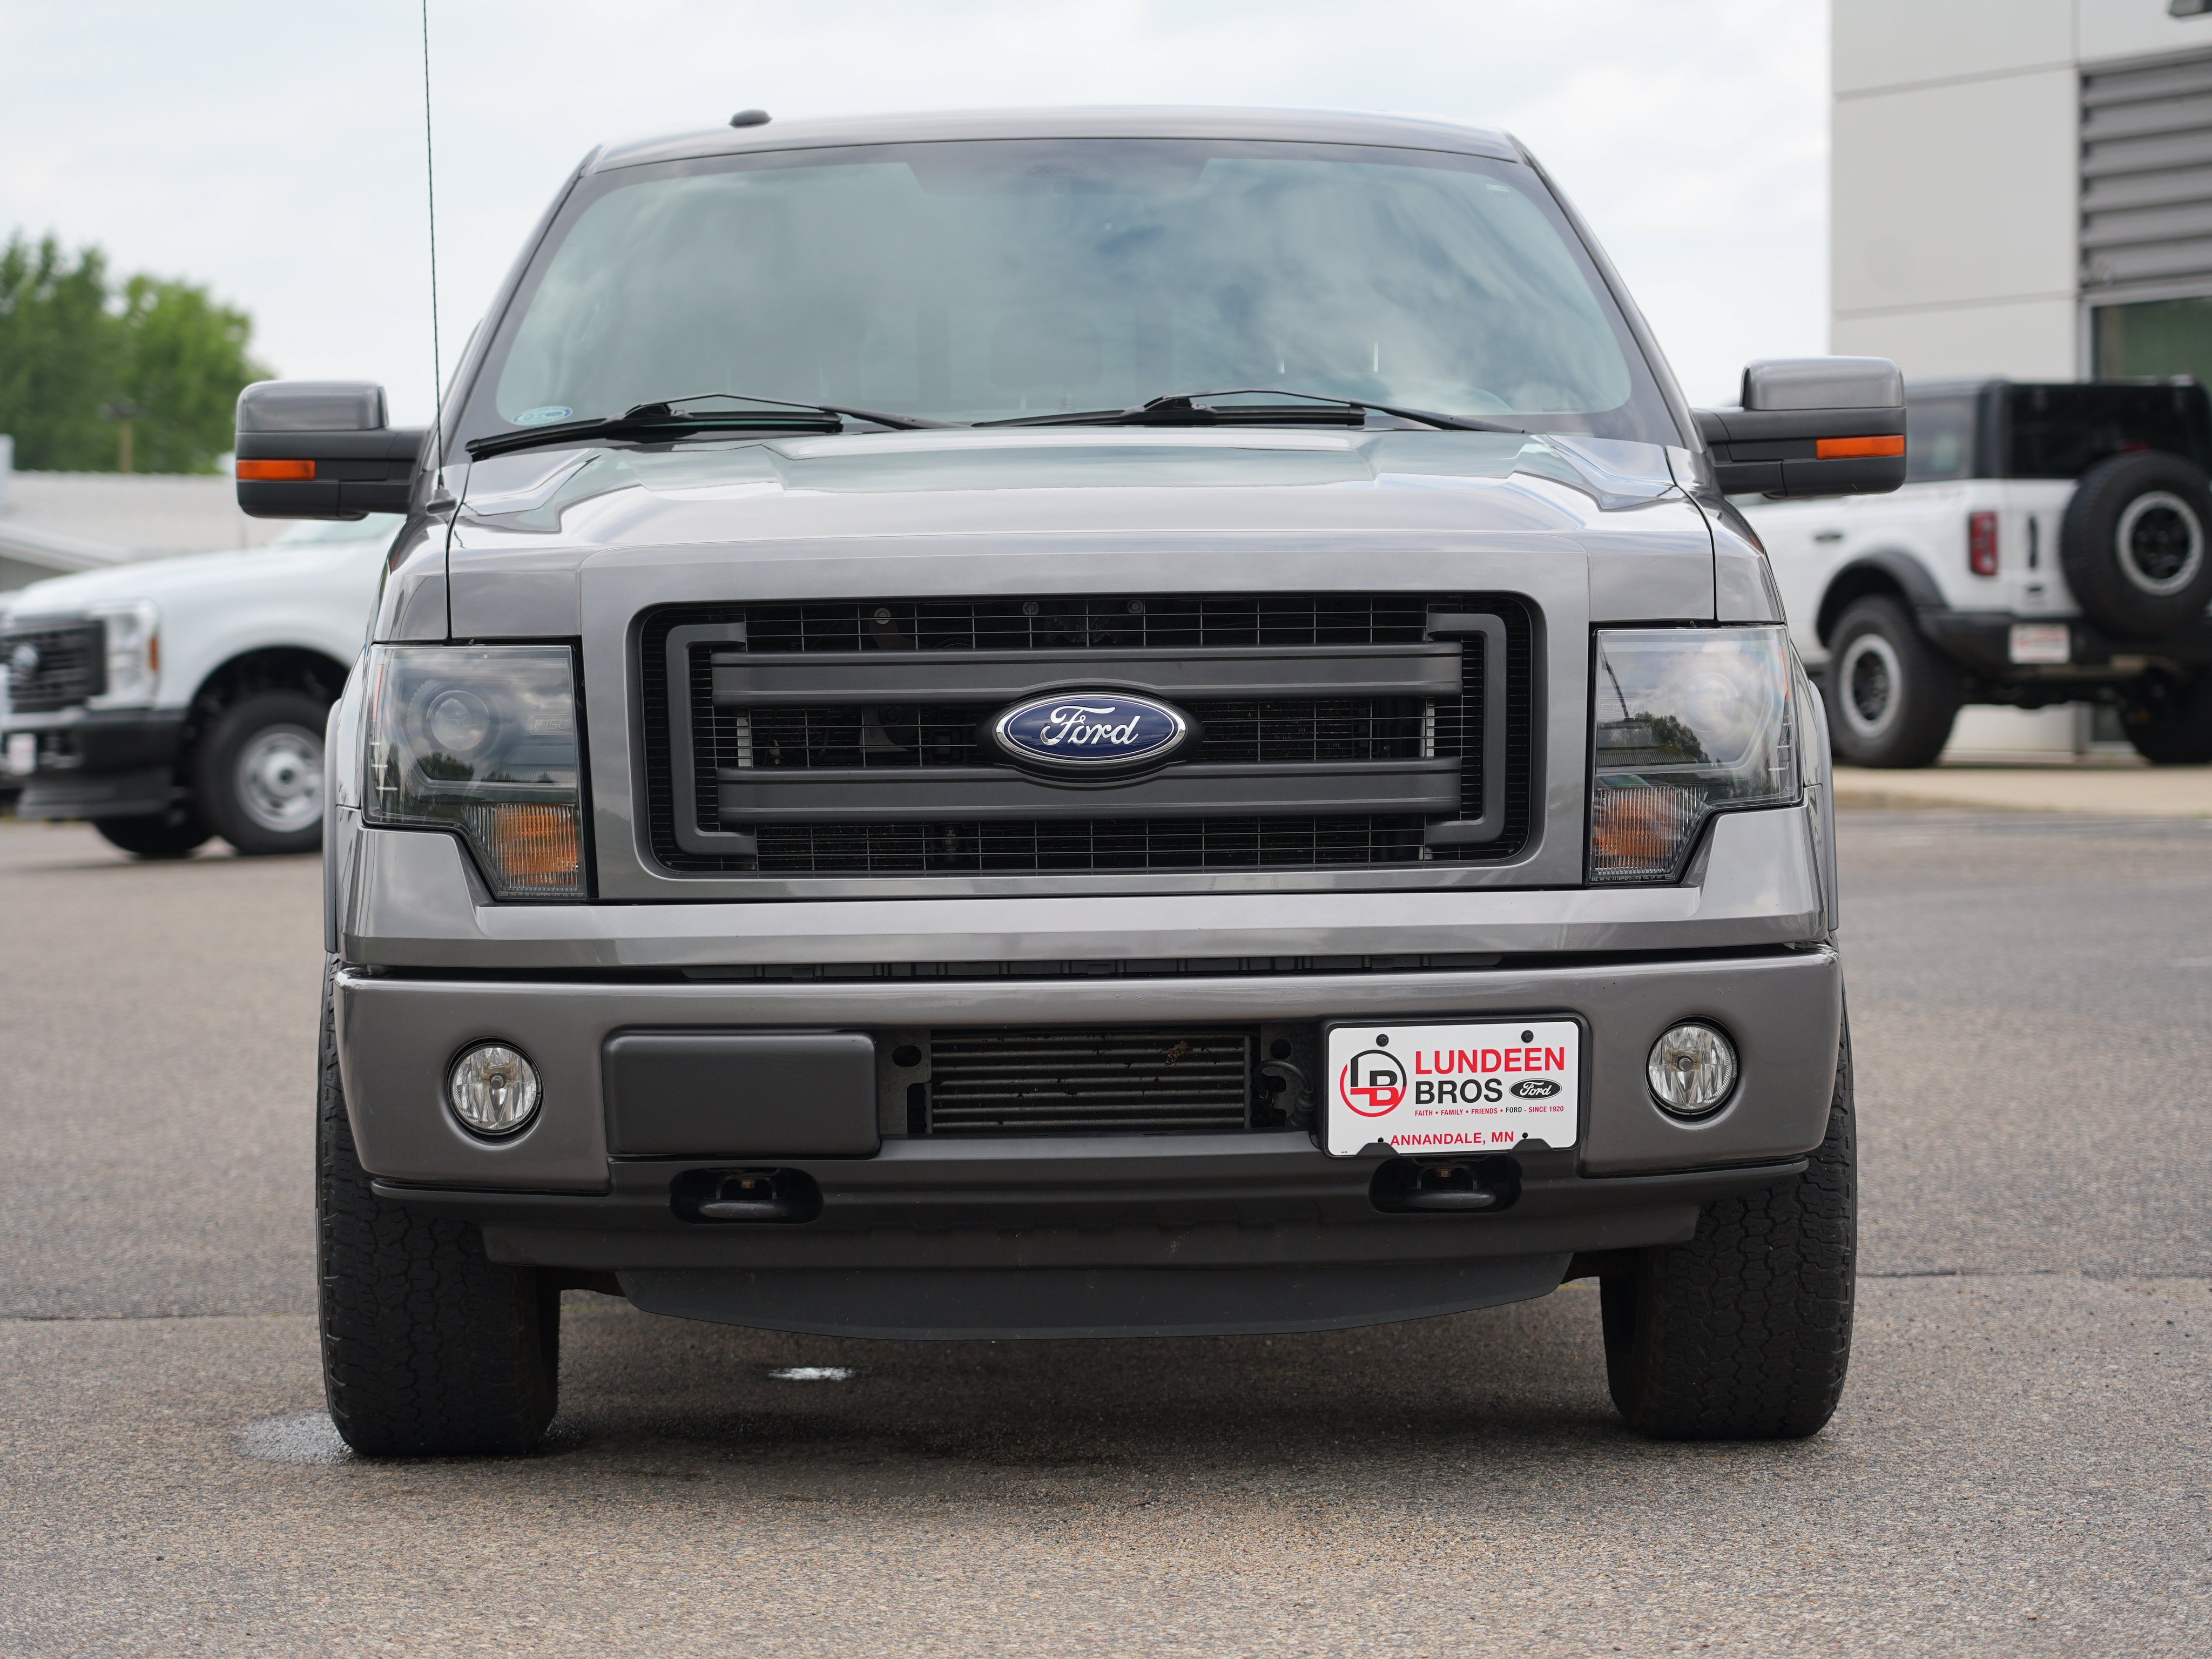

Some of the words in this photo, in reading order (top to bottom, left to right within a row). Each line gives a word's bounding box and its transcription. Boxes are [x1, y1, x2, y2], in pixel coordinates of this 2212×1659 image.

[1040, 705, 1141, 746] Ford
[1415, 1047, 1564, 1074] LUNDEEN
[1415, 1078, 1502, 1104] BROS
[1520, 1082, 1552, 1096] Ford
[1390, 1132, 1485, 1145] ANNANDALE,
[1492, 1131, 1514, 1142] MN
